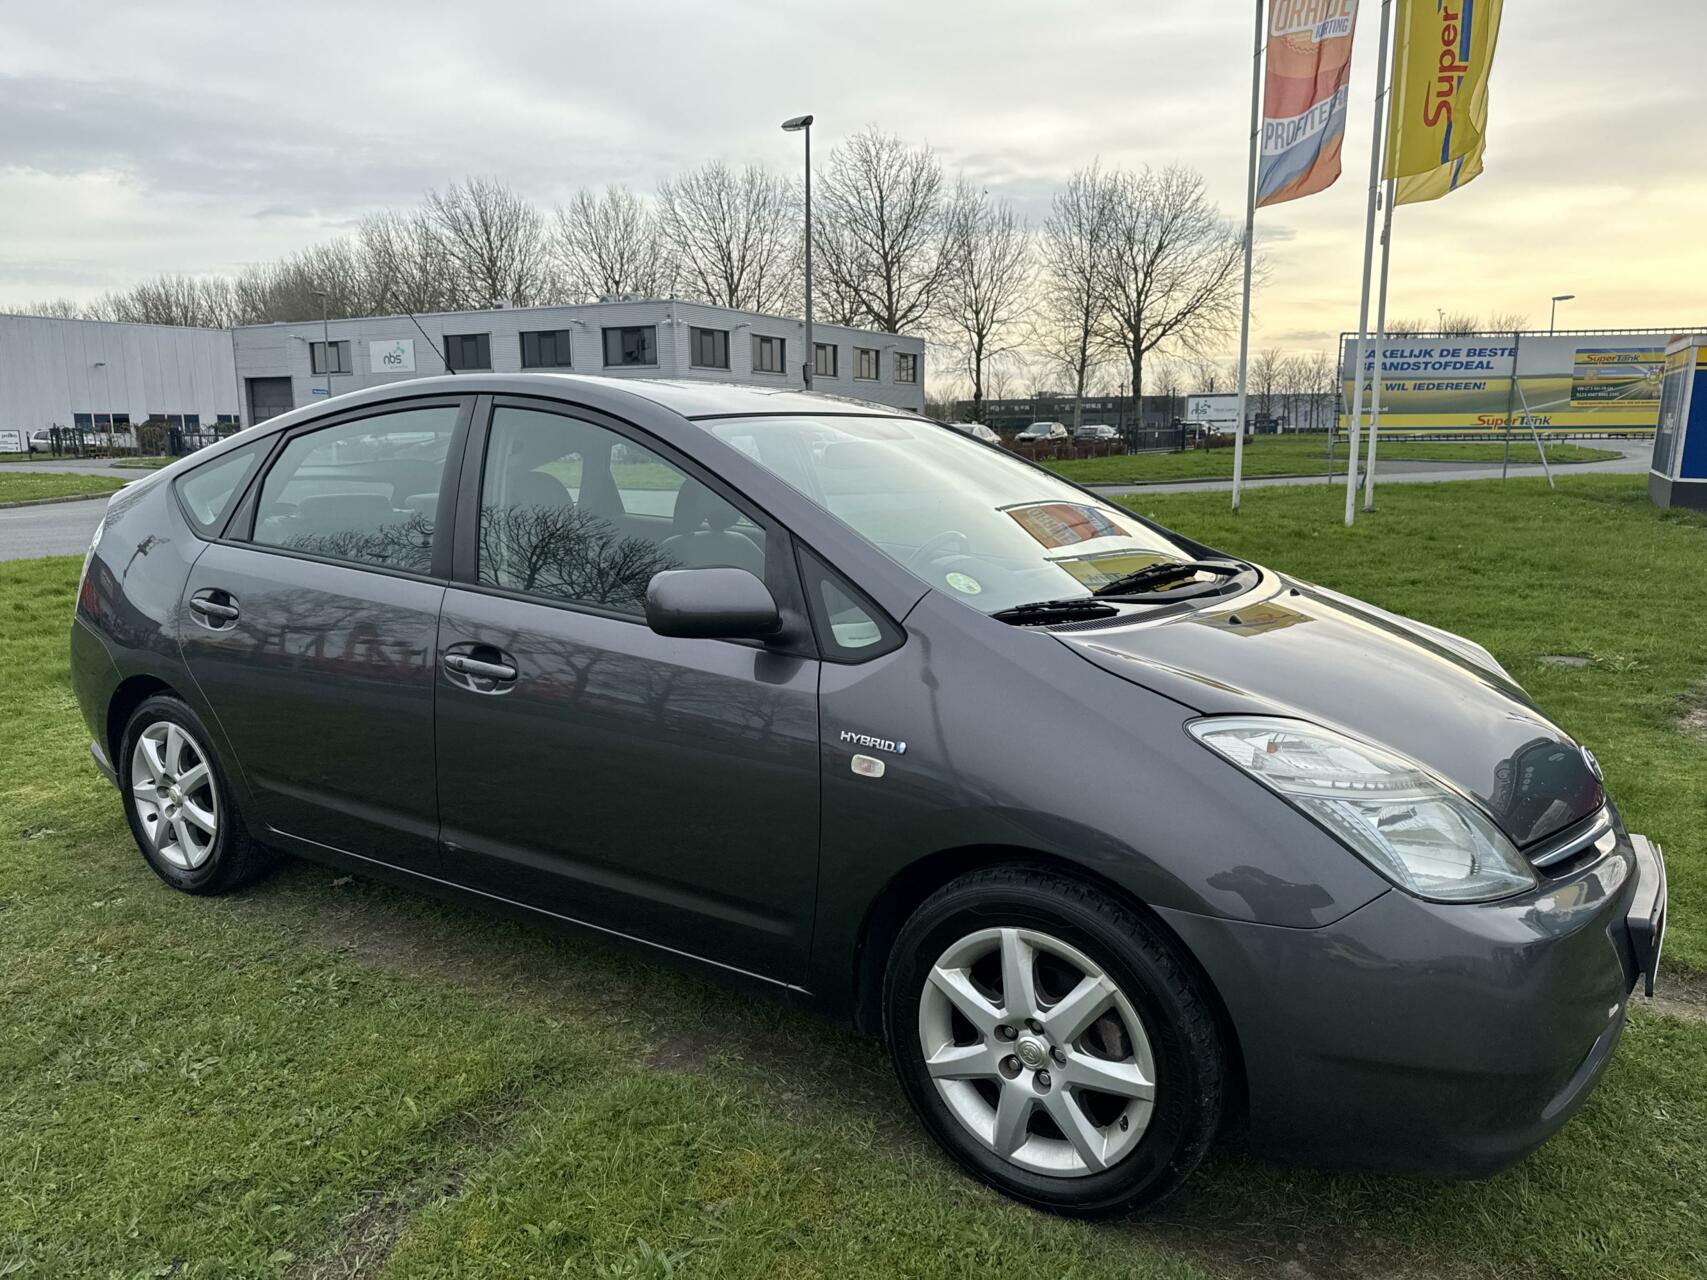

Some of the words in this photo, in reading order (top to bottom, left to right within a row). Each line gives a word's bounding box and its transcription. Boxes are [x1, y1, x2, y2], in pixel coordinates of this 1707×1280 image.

[383, 351, 402, 365] nbs
[1365, 349, 1434, 359] AKELIJK
[1439, 348, 1462, 358] DE
[1466, 347, 1518, 358] BESTE
[1364, 361, 1494, 372] RANDSTOFDEAL
[1385, 382, 1408, 392] WIL
[1412, 382, 1486, 392] IEDEREEN!
[840, 730, 896, 752] HYBRID
